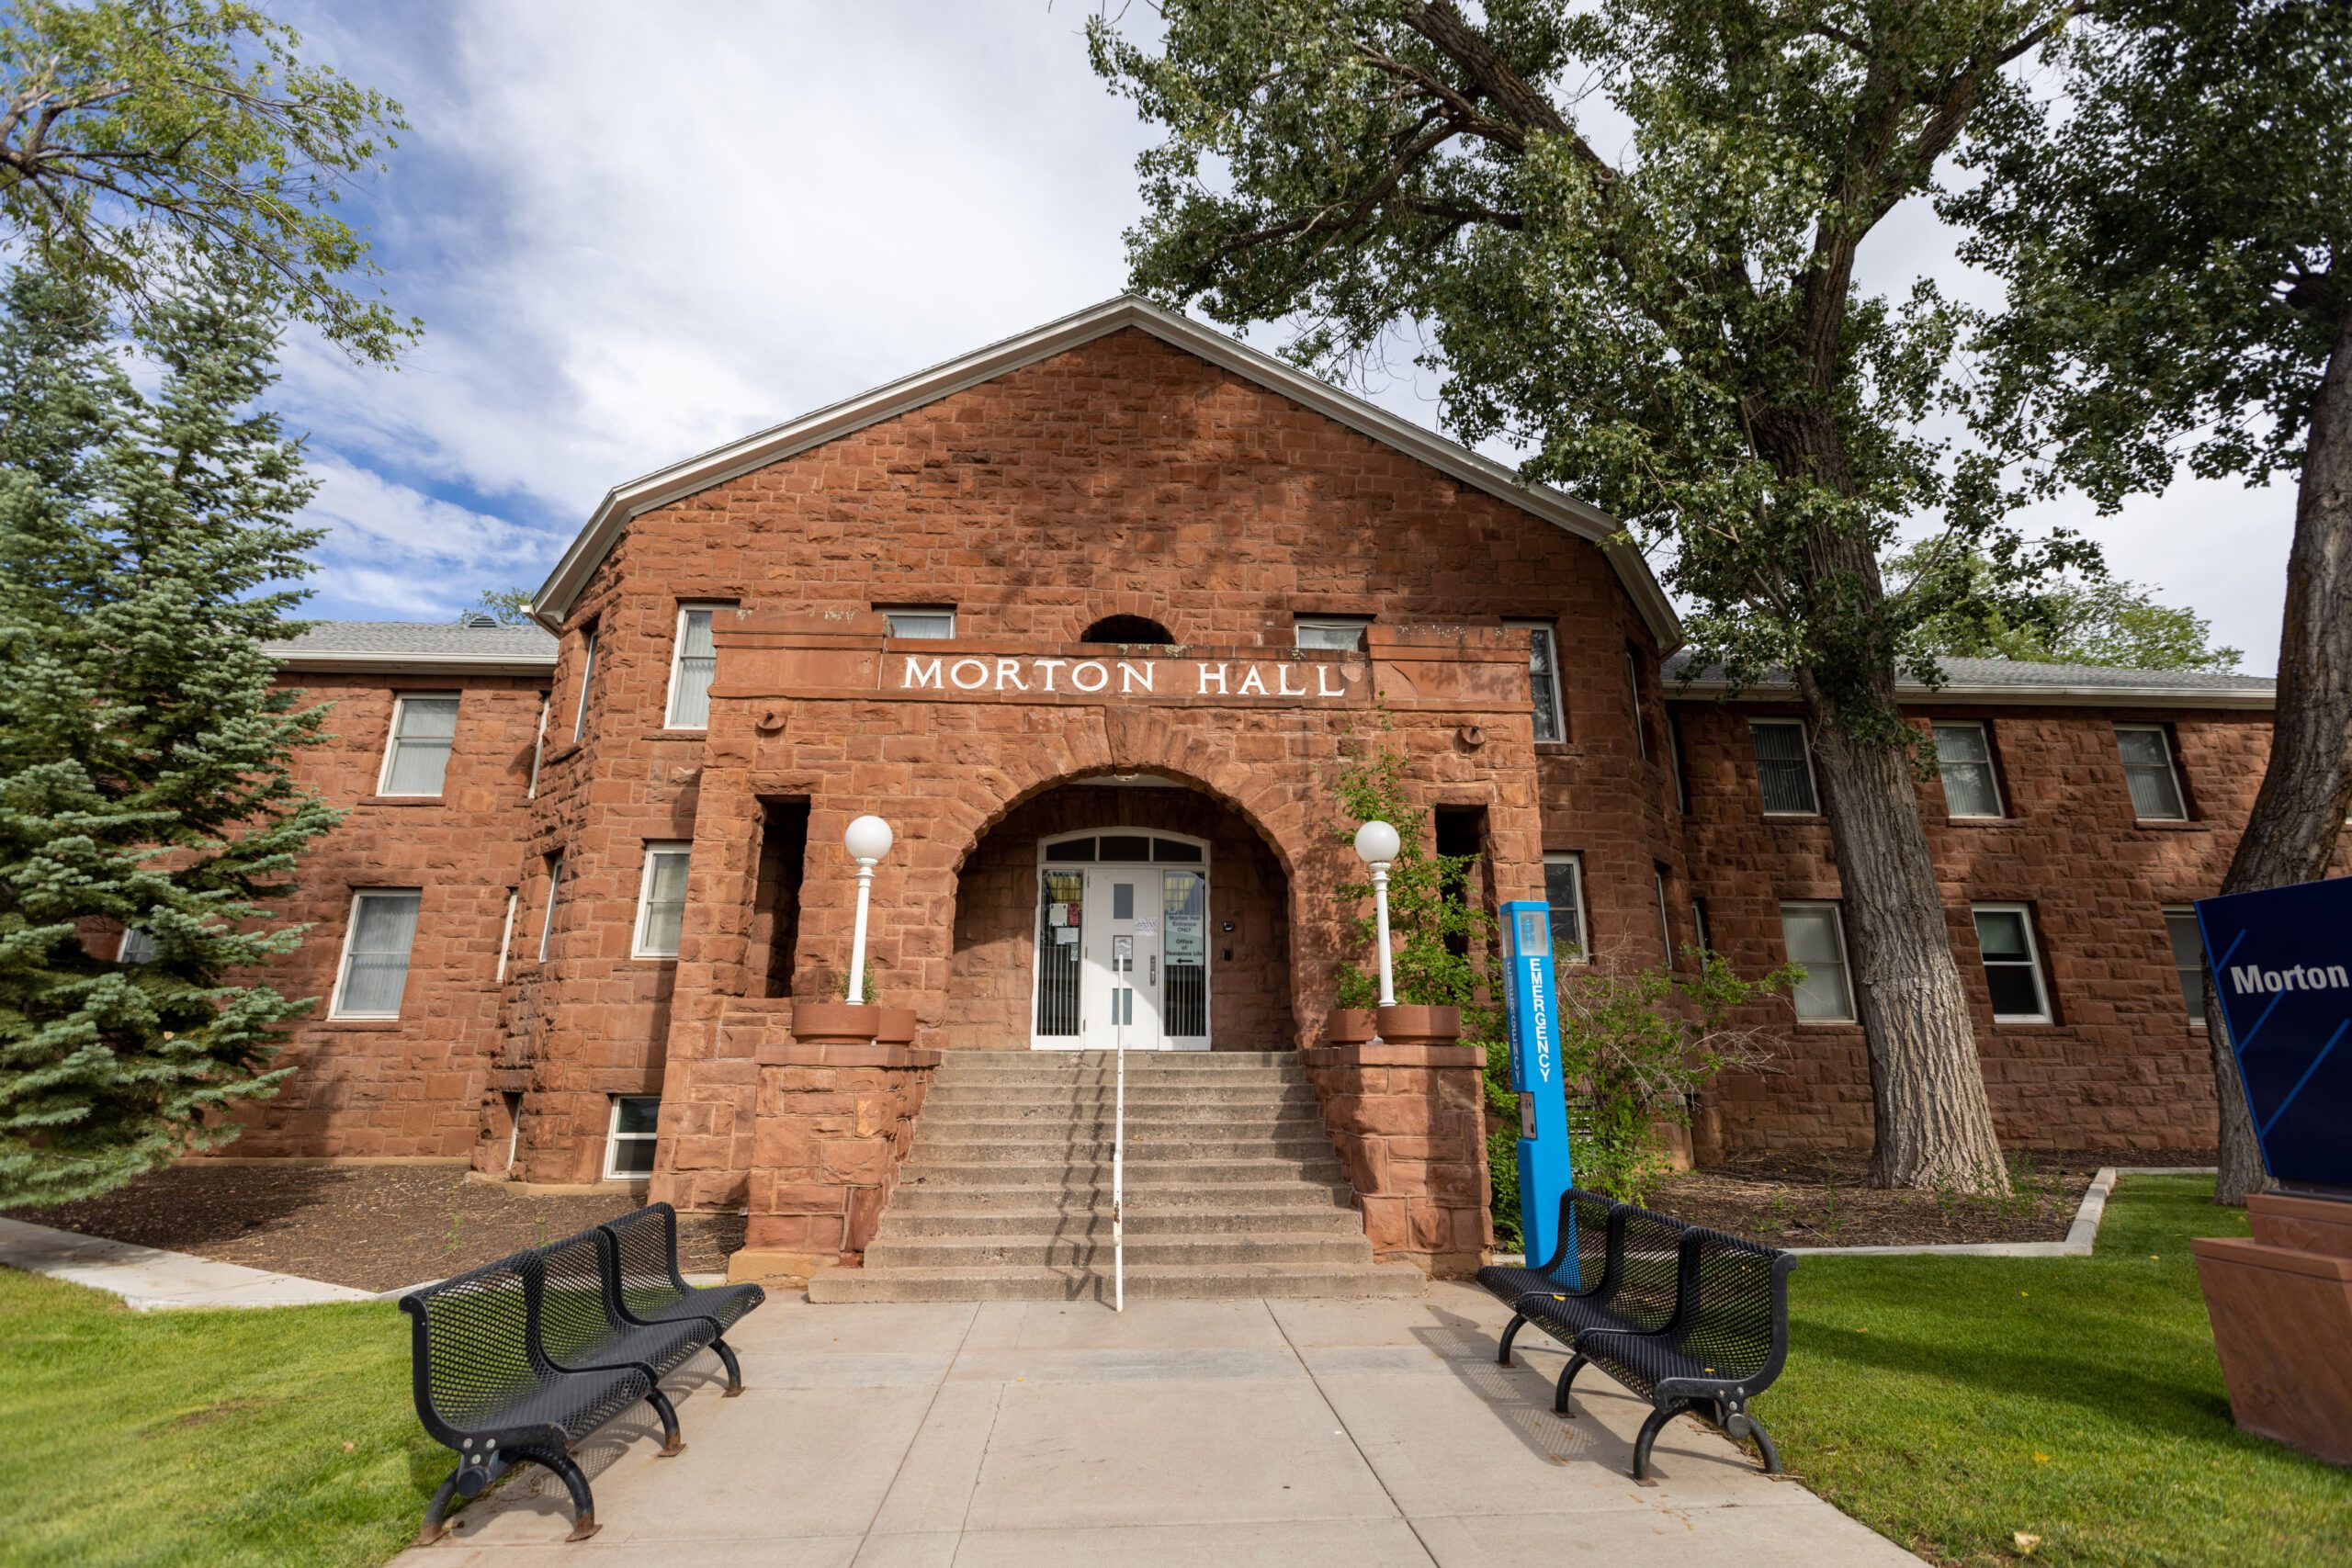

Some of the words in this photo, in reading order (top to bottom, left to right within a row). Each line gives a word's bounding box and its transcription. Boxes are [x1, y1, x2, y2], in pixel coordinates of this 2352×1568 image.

[899, 656, 1155, 694] MORTON
[1196, 662, 1346, 697] HALL
[2230, 964, 2350, 994] Morton
[1507, 962, 1521, 1084] EMERGENCY
[1529, 958, 1551, 1083] EMERGENCY
